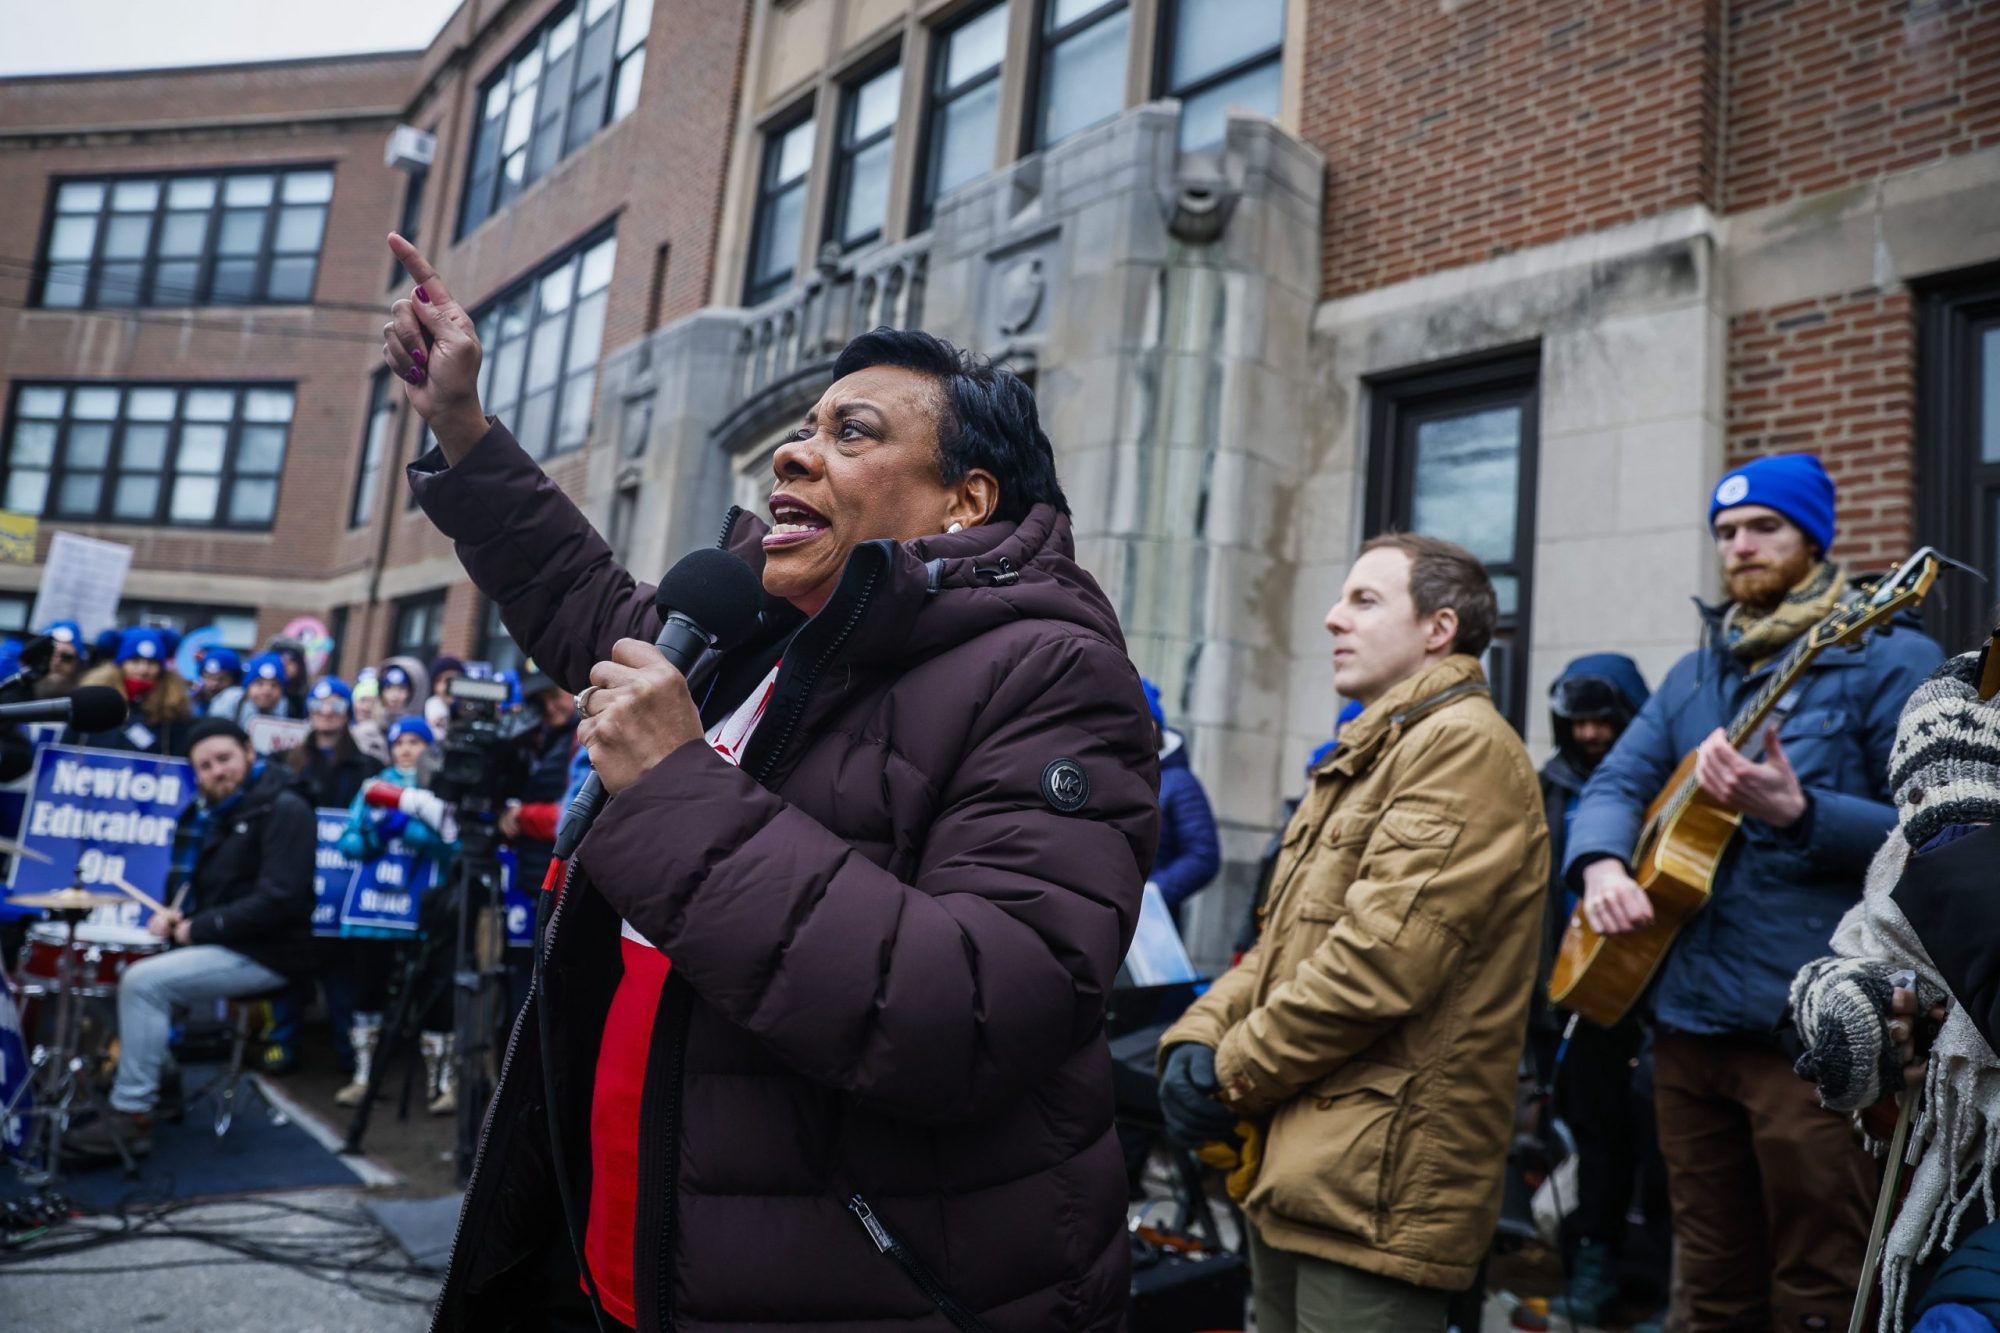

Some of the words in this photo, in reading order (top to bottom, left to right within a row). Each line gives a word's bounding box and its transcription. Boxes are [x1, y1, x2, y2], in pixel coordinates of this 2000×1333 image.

[52, 759, 181, 805] Newton
[1054, 773, 1080, 795] MK
[30, 801, 175, 846] Educator
[80, 849, 125, 884] On
